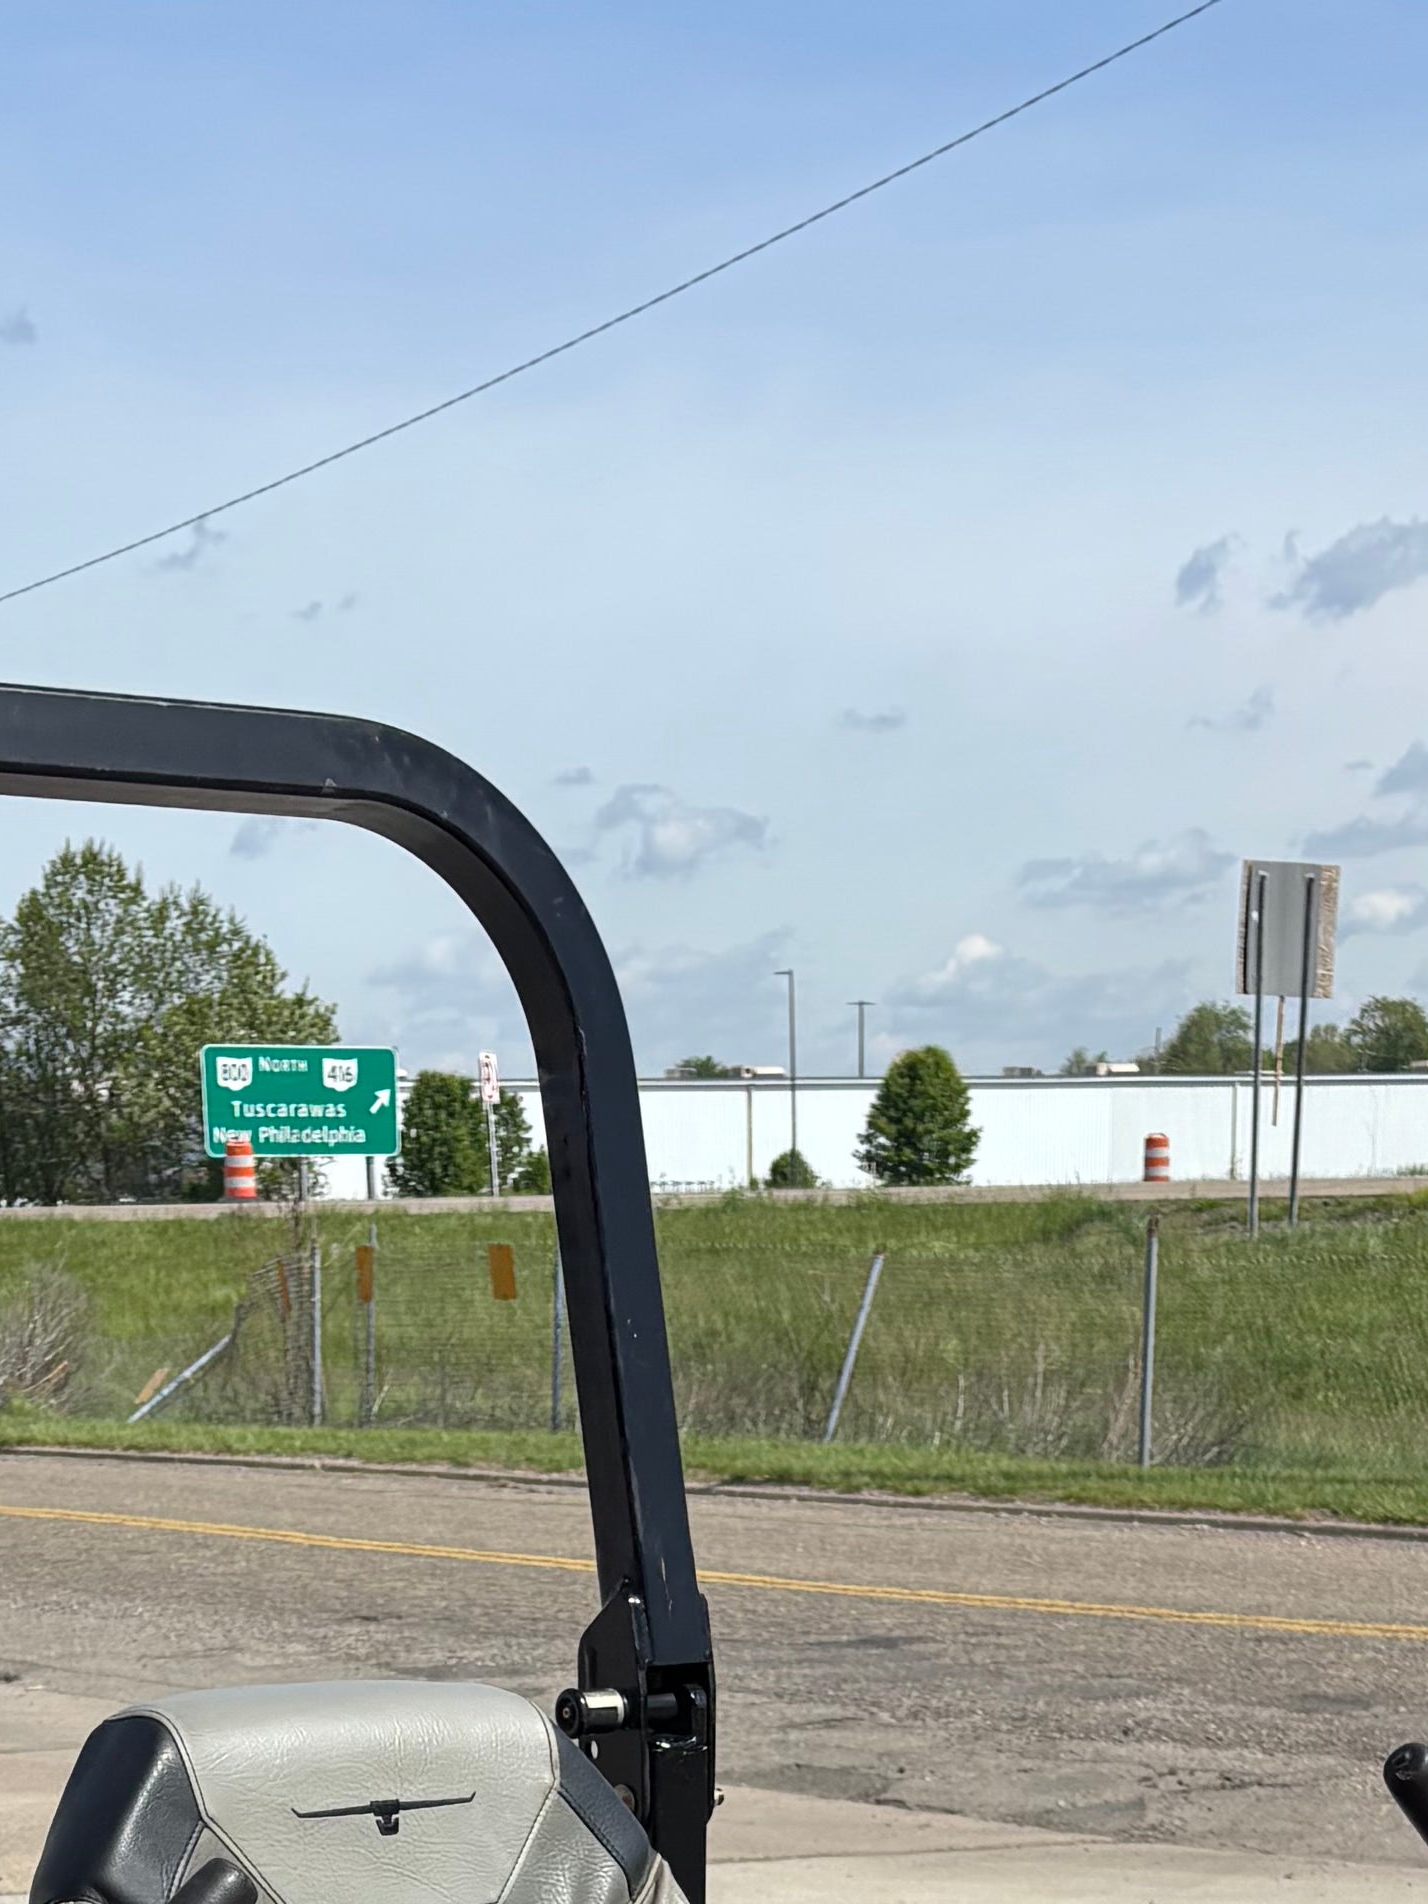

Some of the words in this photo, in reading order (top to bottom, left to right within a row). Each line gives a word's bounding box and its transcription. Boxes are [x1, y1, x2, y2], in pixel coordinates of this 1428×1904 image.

[222, 1064, 249, 1081] 800
[327, 1065, 354, 1083] 416
[231, 1100, 346, 1117] Tuscarawas
[213, 1127, 252, 1143] New
[258, 1126, 366, 1147] Philadelphia
